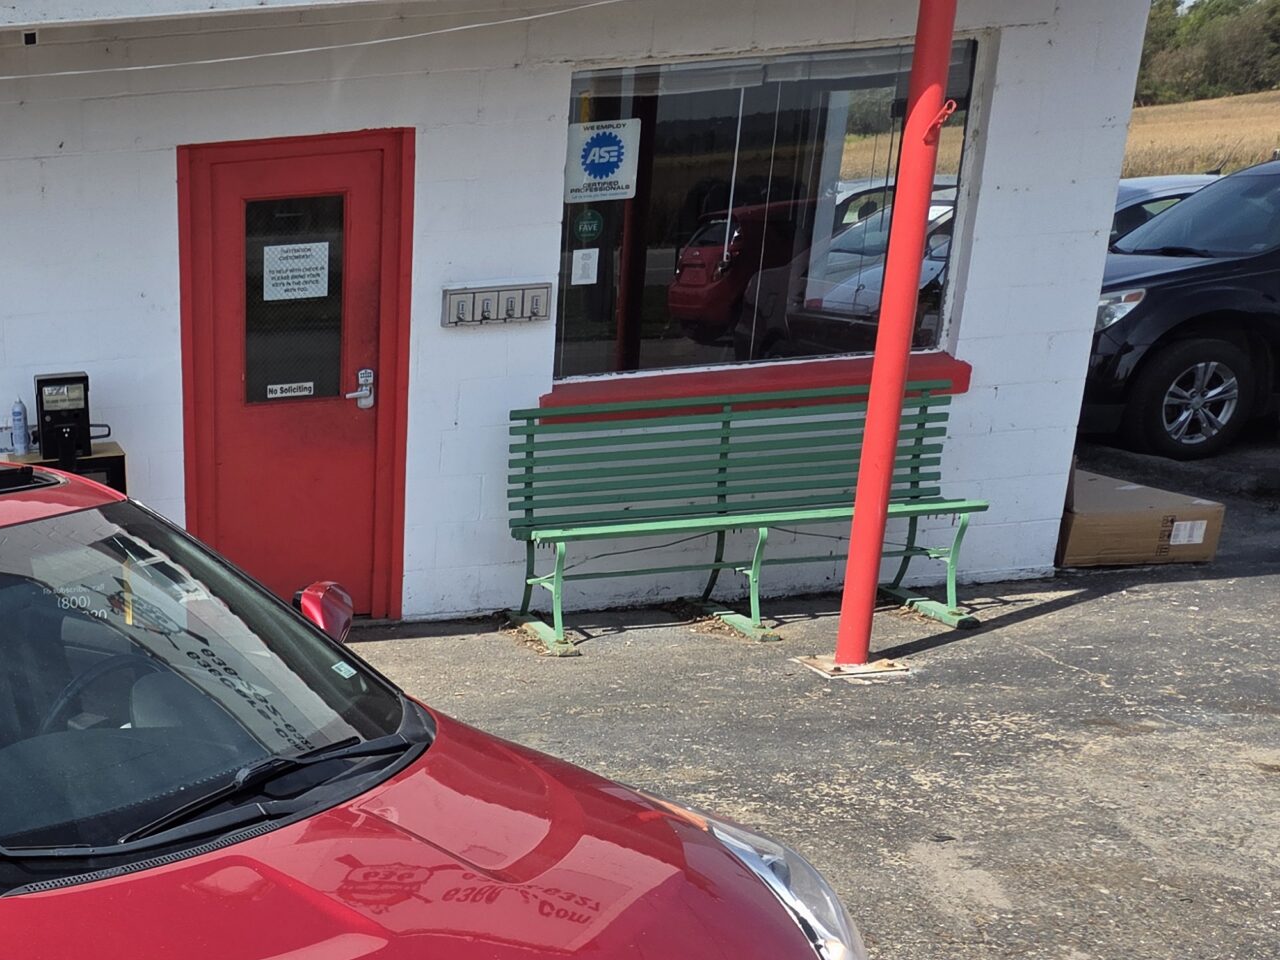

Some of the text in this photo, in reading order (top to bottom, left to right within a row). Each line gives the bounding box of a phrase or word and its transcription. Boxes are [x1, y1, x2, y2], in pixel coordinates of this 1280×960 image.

[586, 146, 619, 164] ASE
[570, 184, 630, 193] PROFESSIONALS
[583, 180, 619, 188] CERTIFIED
[578, 223, 598, 232] FAVE
[268, 384, 312, 396] No Soliciting
[57, 595, 91, 609] (800)
